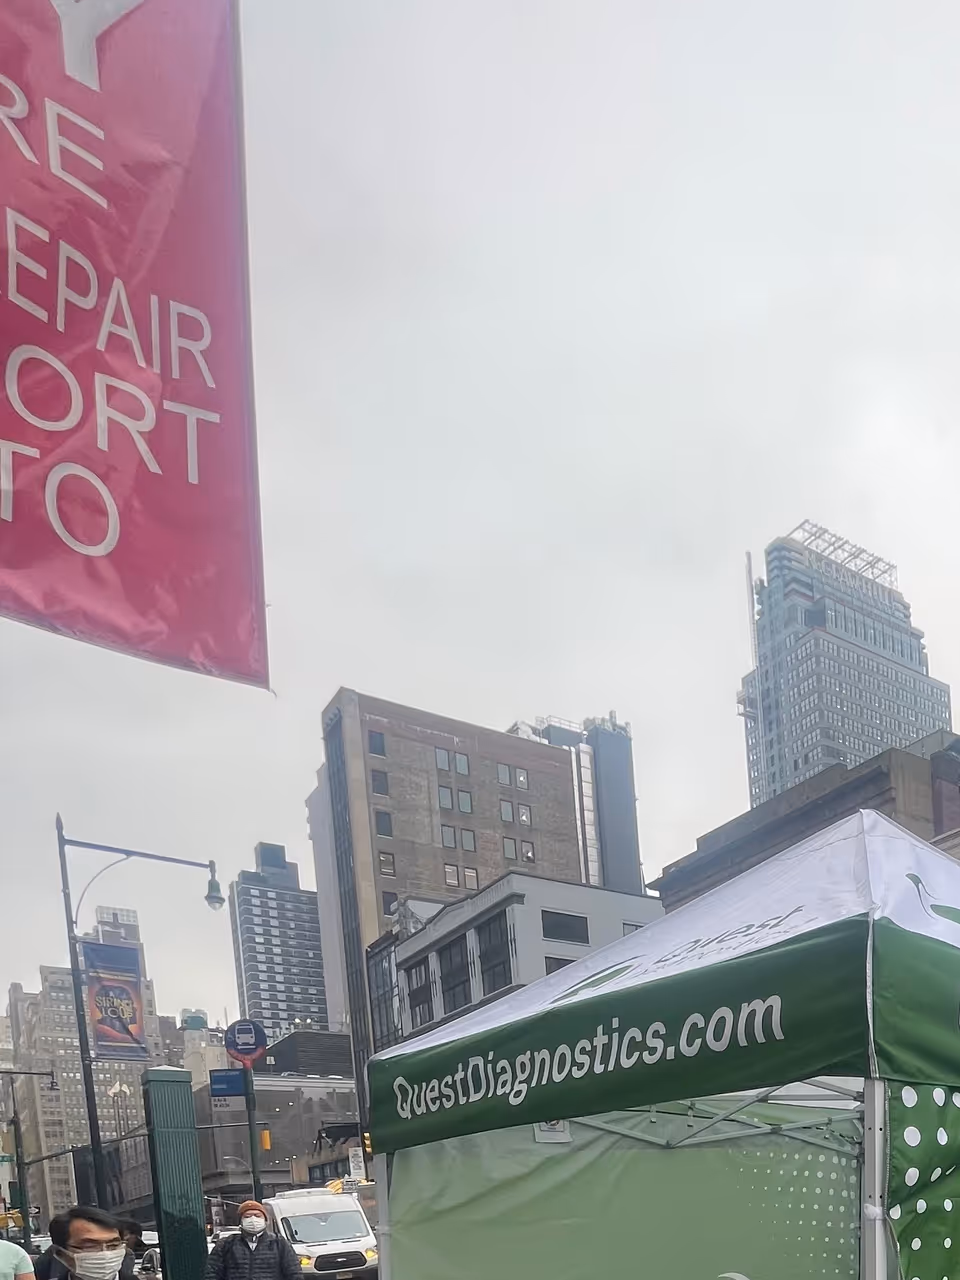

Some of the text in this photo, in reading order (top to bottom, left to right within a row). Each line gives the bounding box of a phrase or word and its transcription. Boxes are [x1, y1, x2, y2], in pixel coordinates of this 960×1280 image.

[7, 208, 216, 388] EPAIR
[5, 344, 220, 484] ORT
[0, 441, 120, 556] TO
[394, 995, 785, 1118] QuestDiagnostics.com
